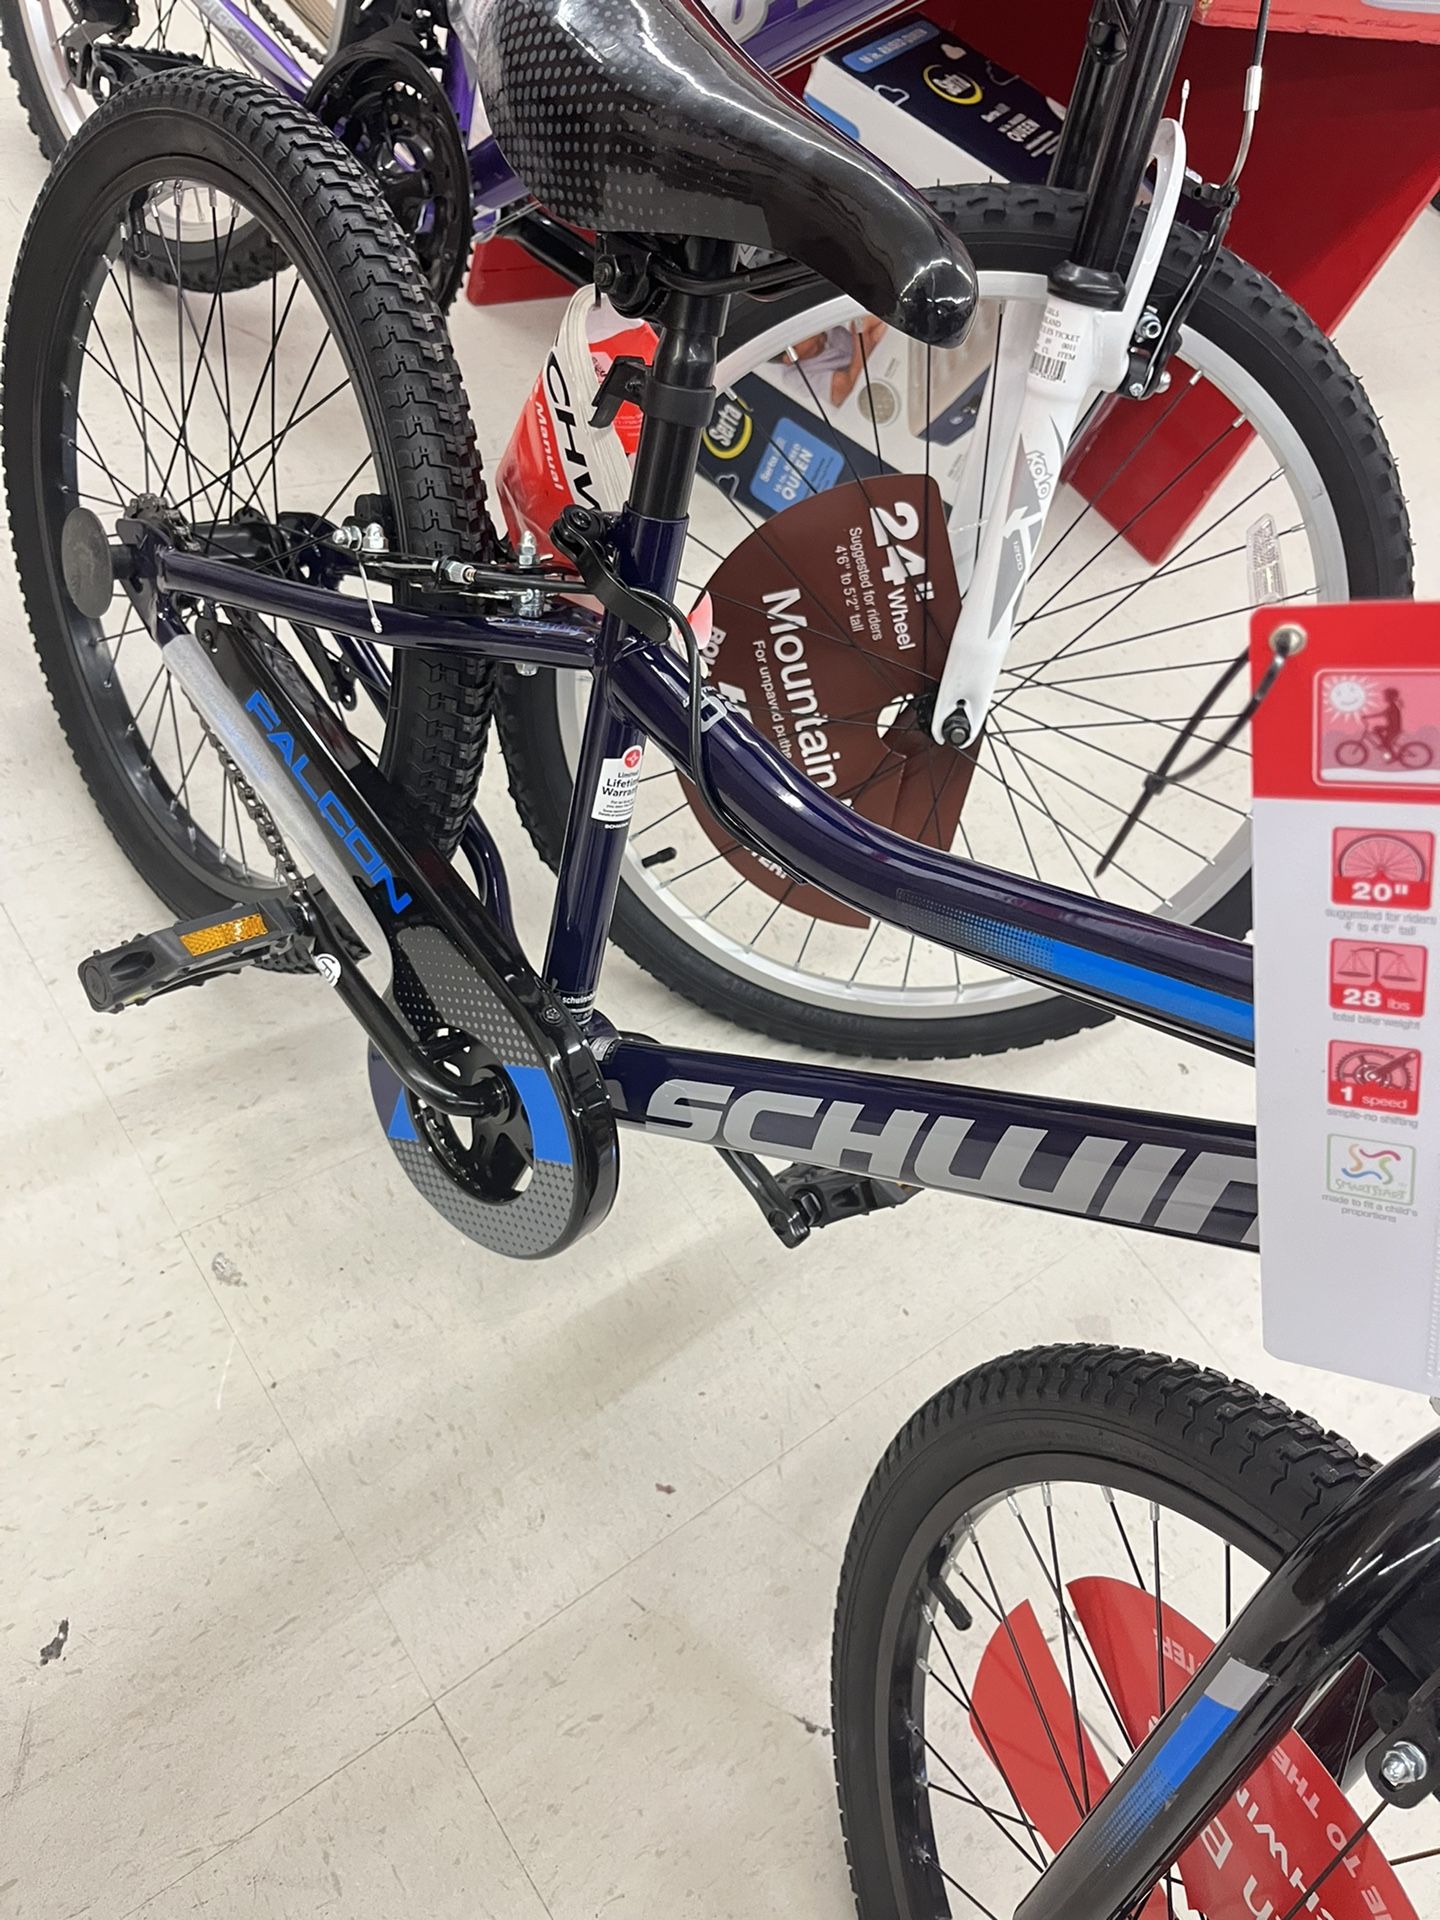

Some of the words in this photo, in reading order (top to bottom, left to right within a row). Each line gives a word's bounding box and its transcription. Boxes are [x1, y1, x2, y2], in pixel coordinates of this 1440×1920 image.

[709, 404, 743, 447] Serta
[535, 401, 564, 491] Manual
[849, 527, 874, 591] Suggested
[840, 573, 853, 585] to
[849, 612, 865, 632] tall
[863, 590, 876, 607] for
[867, 610, 883, 641] riders
[887, 588, 916, 650] Wheel
[753, 640, 767, 665] For
[762, 588, 840, 789] Mountain
[245, 690, 413, 914] FALCON
[1352, 882, 1409, 901] 20"
[1342, 988, 1382, 1008] 28
[1387, 998, 1411, 1012] lbs
[1332, 1011, 1355, 1024] total
[1340, 1086, 1353, 1102] 1
[1362, 1094, 1408, 1111] speed
[1380, 1114, 1419, 1130] shifting
[1322, 1193, 1349, 1206] made
[1351, 1196, 1362, 1209] to
[1363, 1197, 1375, 1210] fit
[1384, 1202, 1418, 1217] child's
[1341, 1206, 1397, 1224] proportions
[1271, 1745, 1321, 1819] THE
[1326, 1822, 1361, 1878] TO
